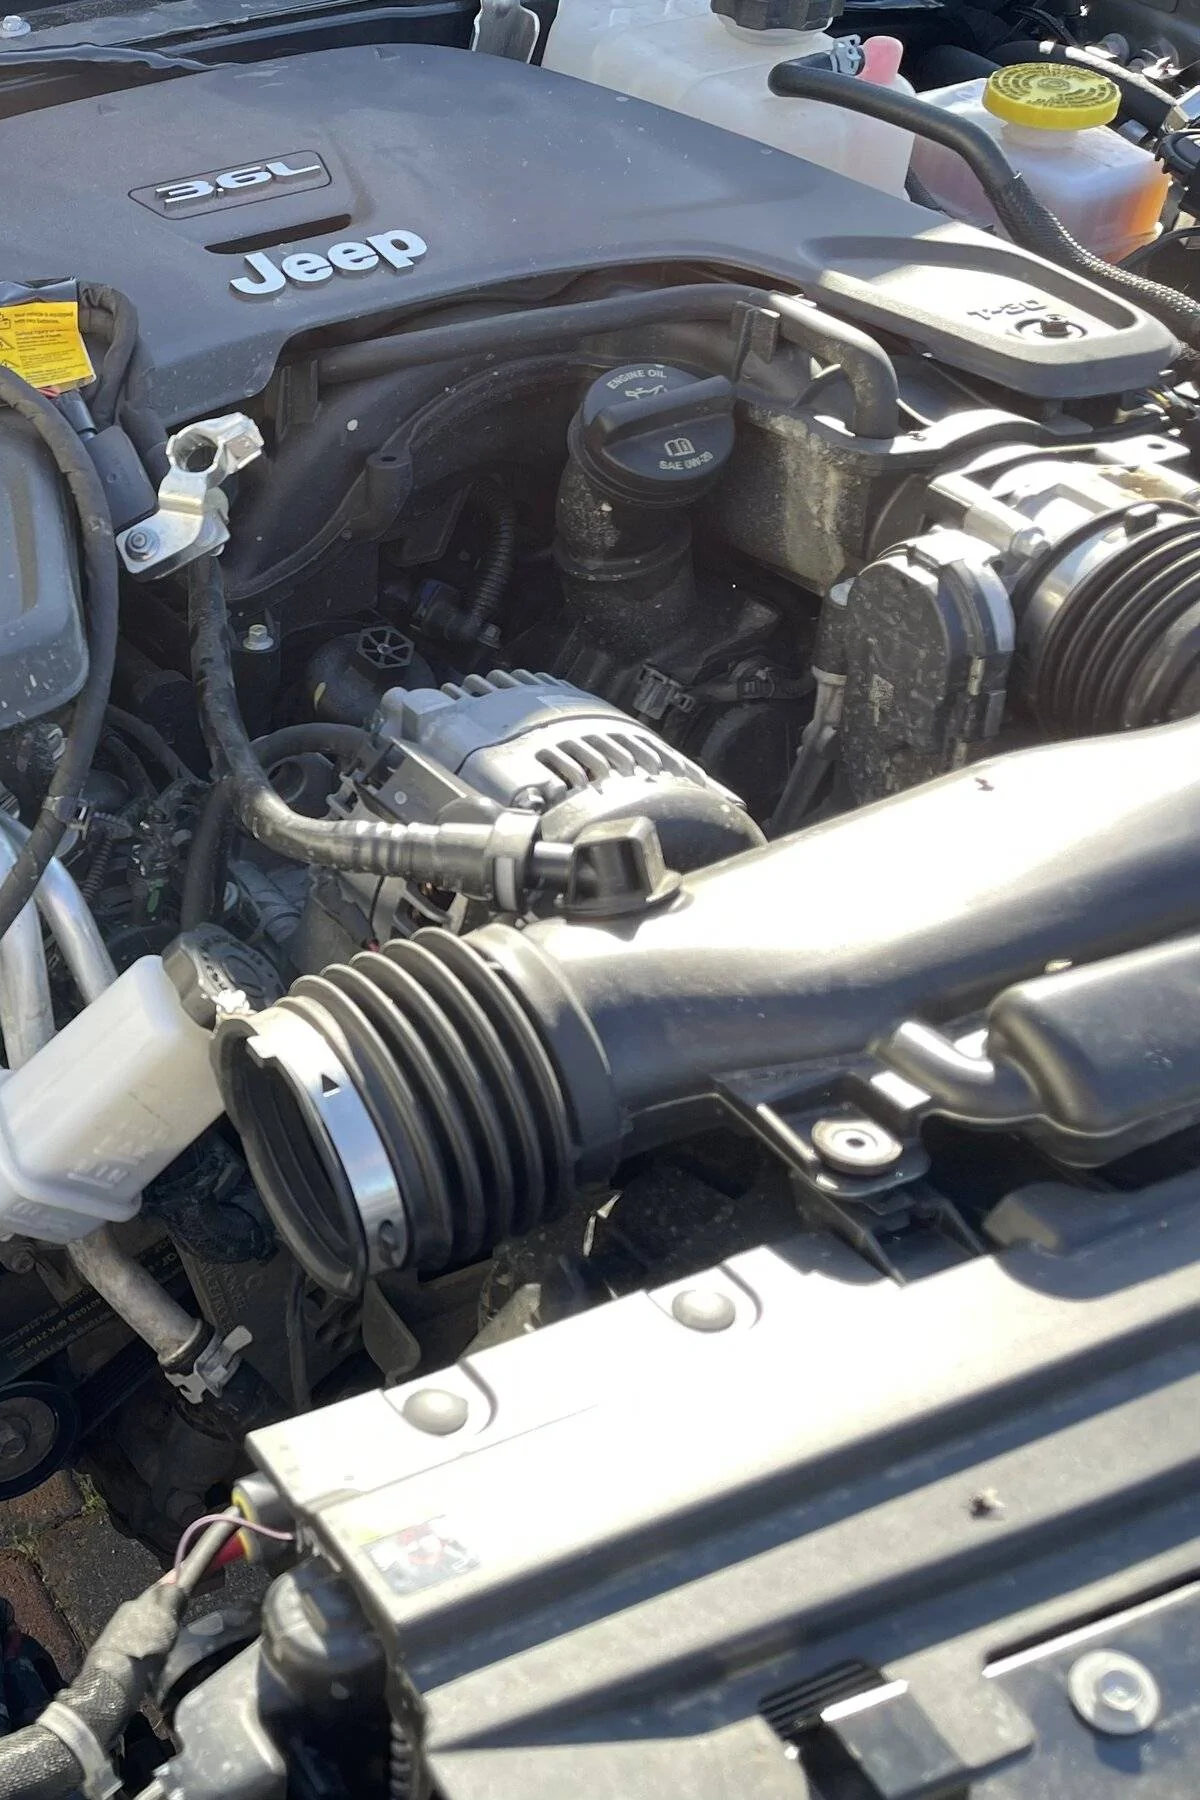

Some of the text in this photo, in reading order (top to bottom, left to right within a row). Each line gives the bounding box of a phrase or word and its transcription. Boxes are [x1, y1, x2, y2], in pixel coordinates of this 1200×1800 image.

[155, 161, 321, 206] 3.6L
[230, 229, 428, 298] Jeep
[606, 369, 668, 390] ENGINE OIL
[659, 459, 684, 471] SAE
